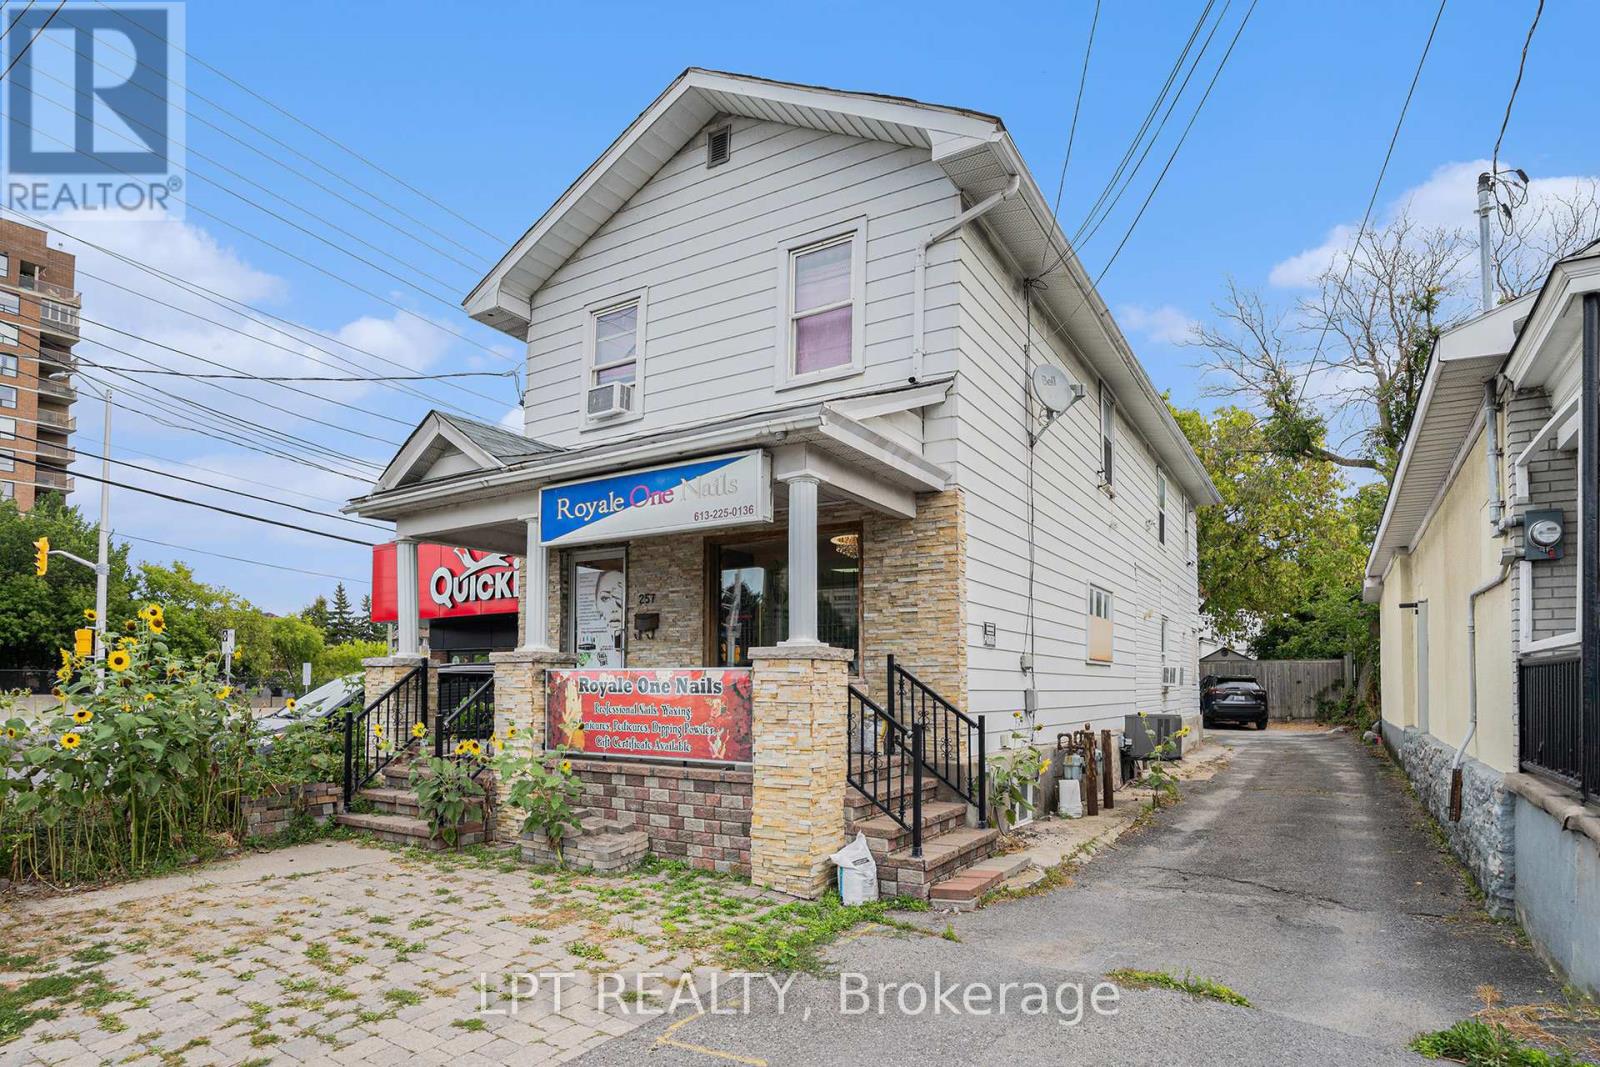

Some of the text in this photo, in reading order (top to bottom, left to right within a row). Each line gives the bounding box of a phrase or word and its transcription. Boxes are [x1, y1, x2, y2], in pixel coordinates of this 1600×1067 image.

[1041, 375, 1057, 386] Bell
[557, 472, 738, 521] Royale One Nails
[694, 504, 754, 521] 613-225-0136
[639, 593, 656, 604] 257
[578, 677, 722, 697] Royale One Nails
[594, 702, 637, 716] Professional
[661, 704, 692, 720] Waxing
[652, 721, 682, 738] Dipping
[595, 735, 691, 753] Gift Certificate Available
